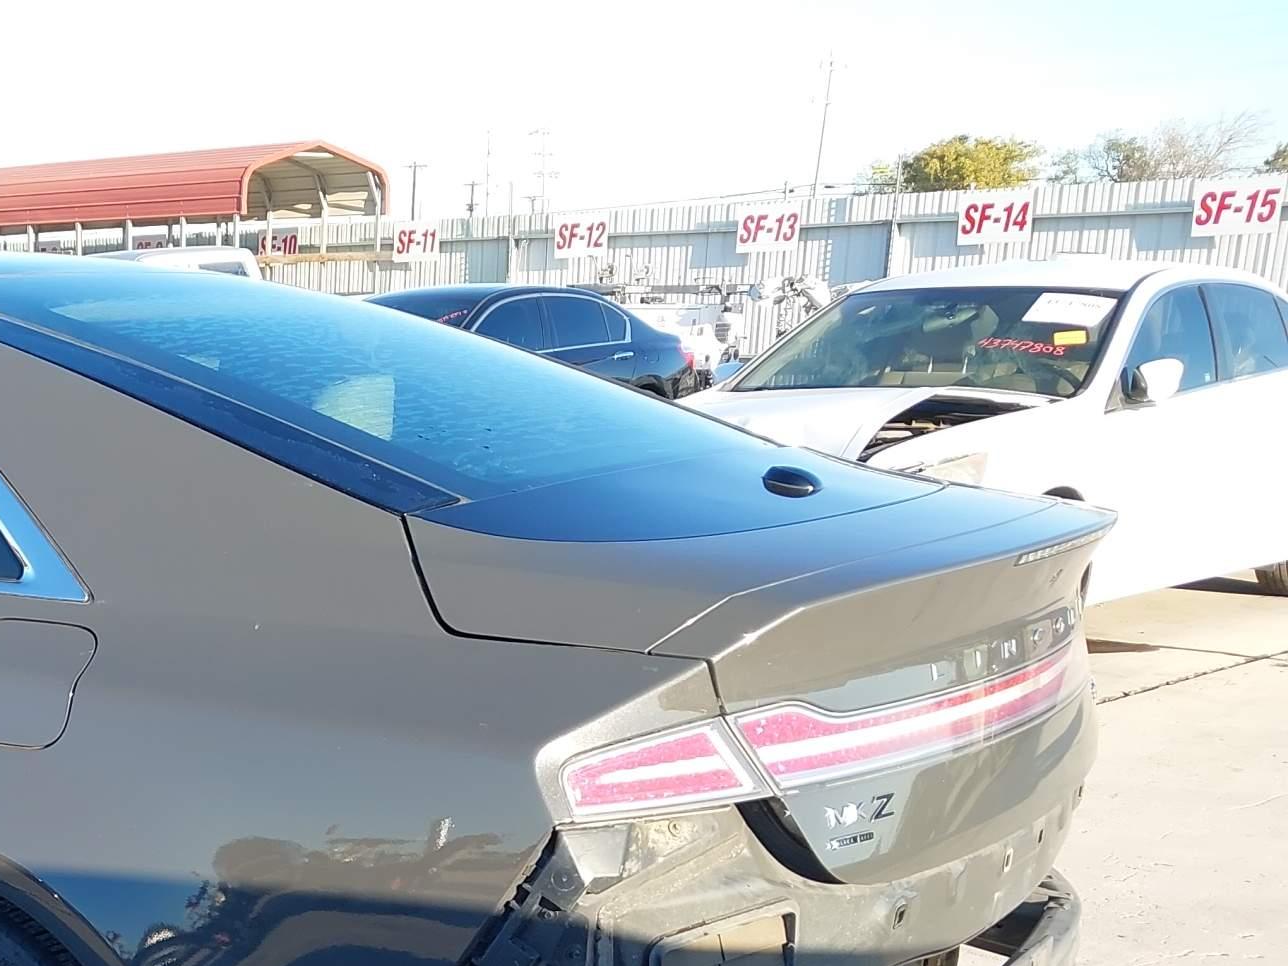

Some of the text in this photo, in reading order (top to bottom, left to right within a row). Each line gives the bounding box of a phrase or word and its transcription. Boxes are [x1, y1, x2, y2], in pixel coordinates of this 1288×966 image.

[961, 201, 1030, 236] SF-14
[1194, 188, 1281, 226] SF-15
[397, 228, 438, 255] SF-11
[556, 220, 607, 251] SF-12
[739, 213, 799, 244] SF-13
